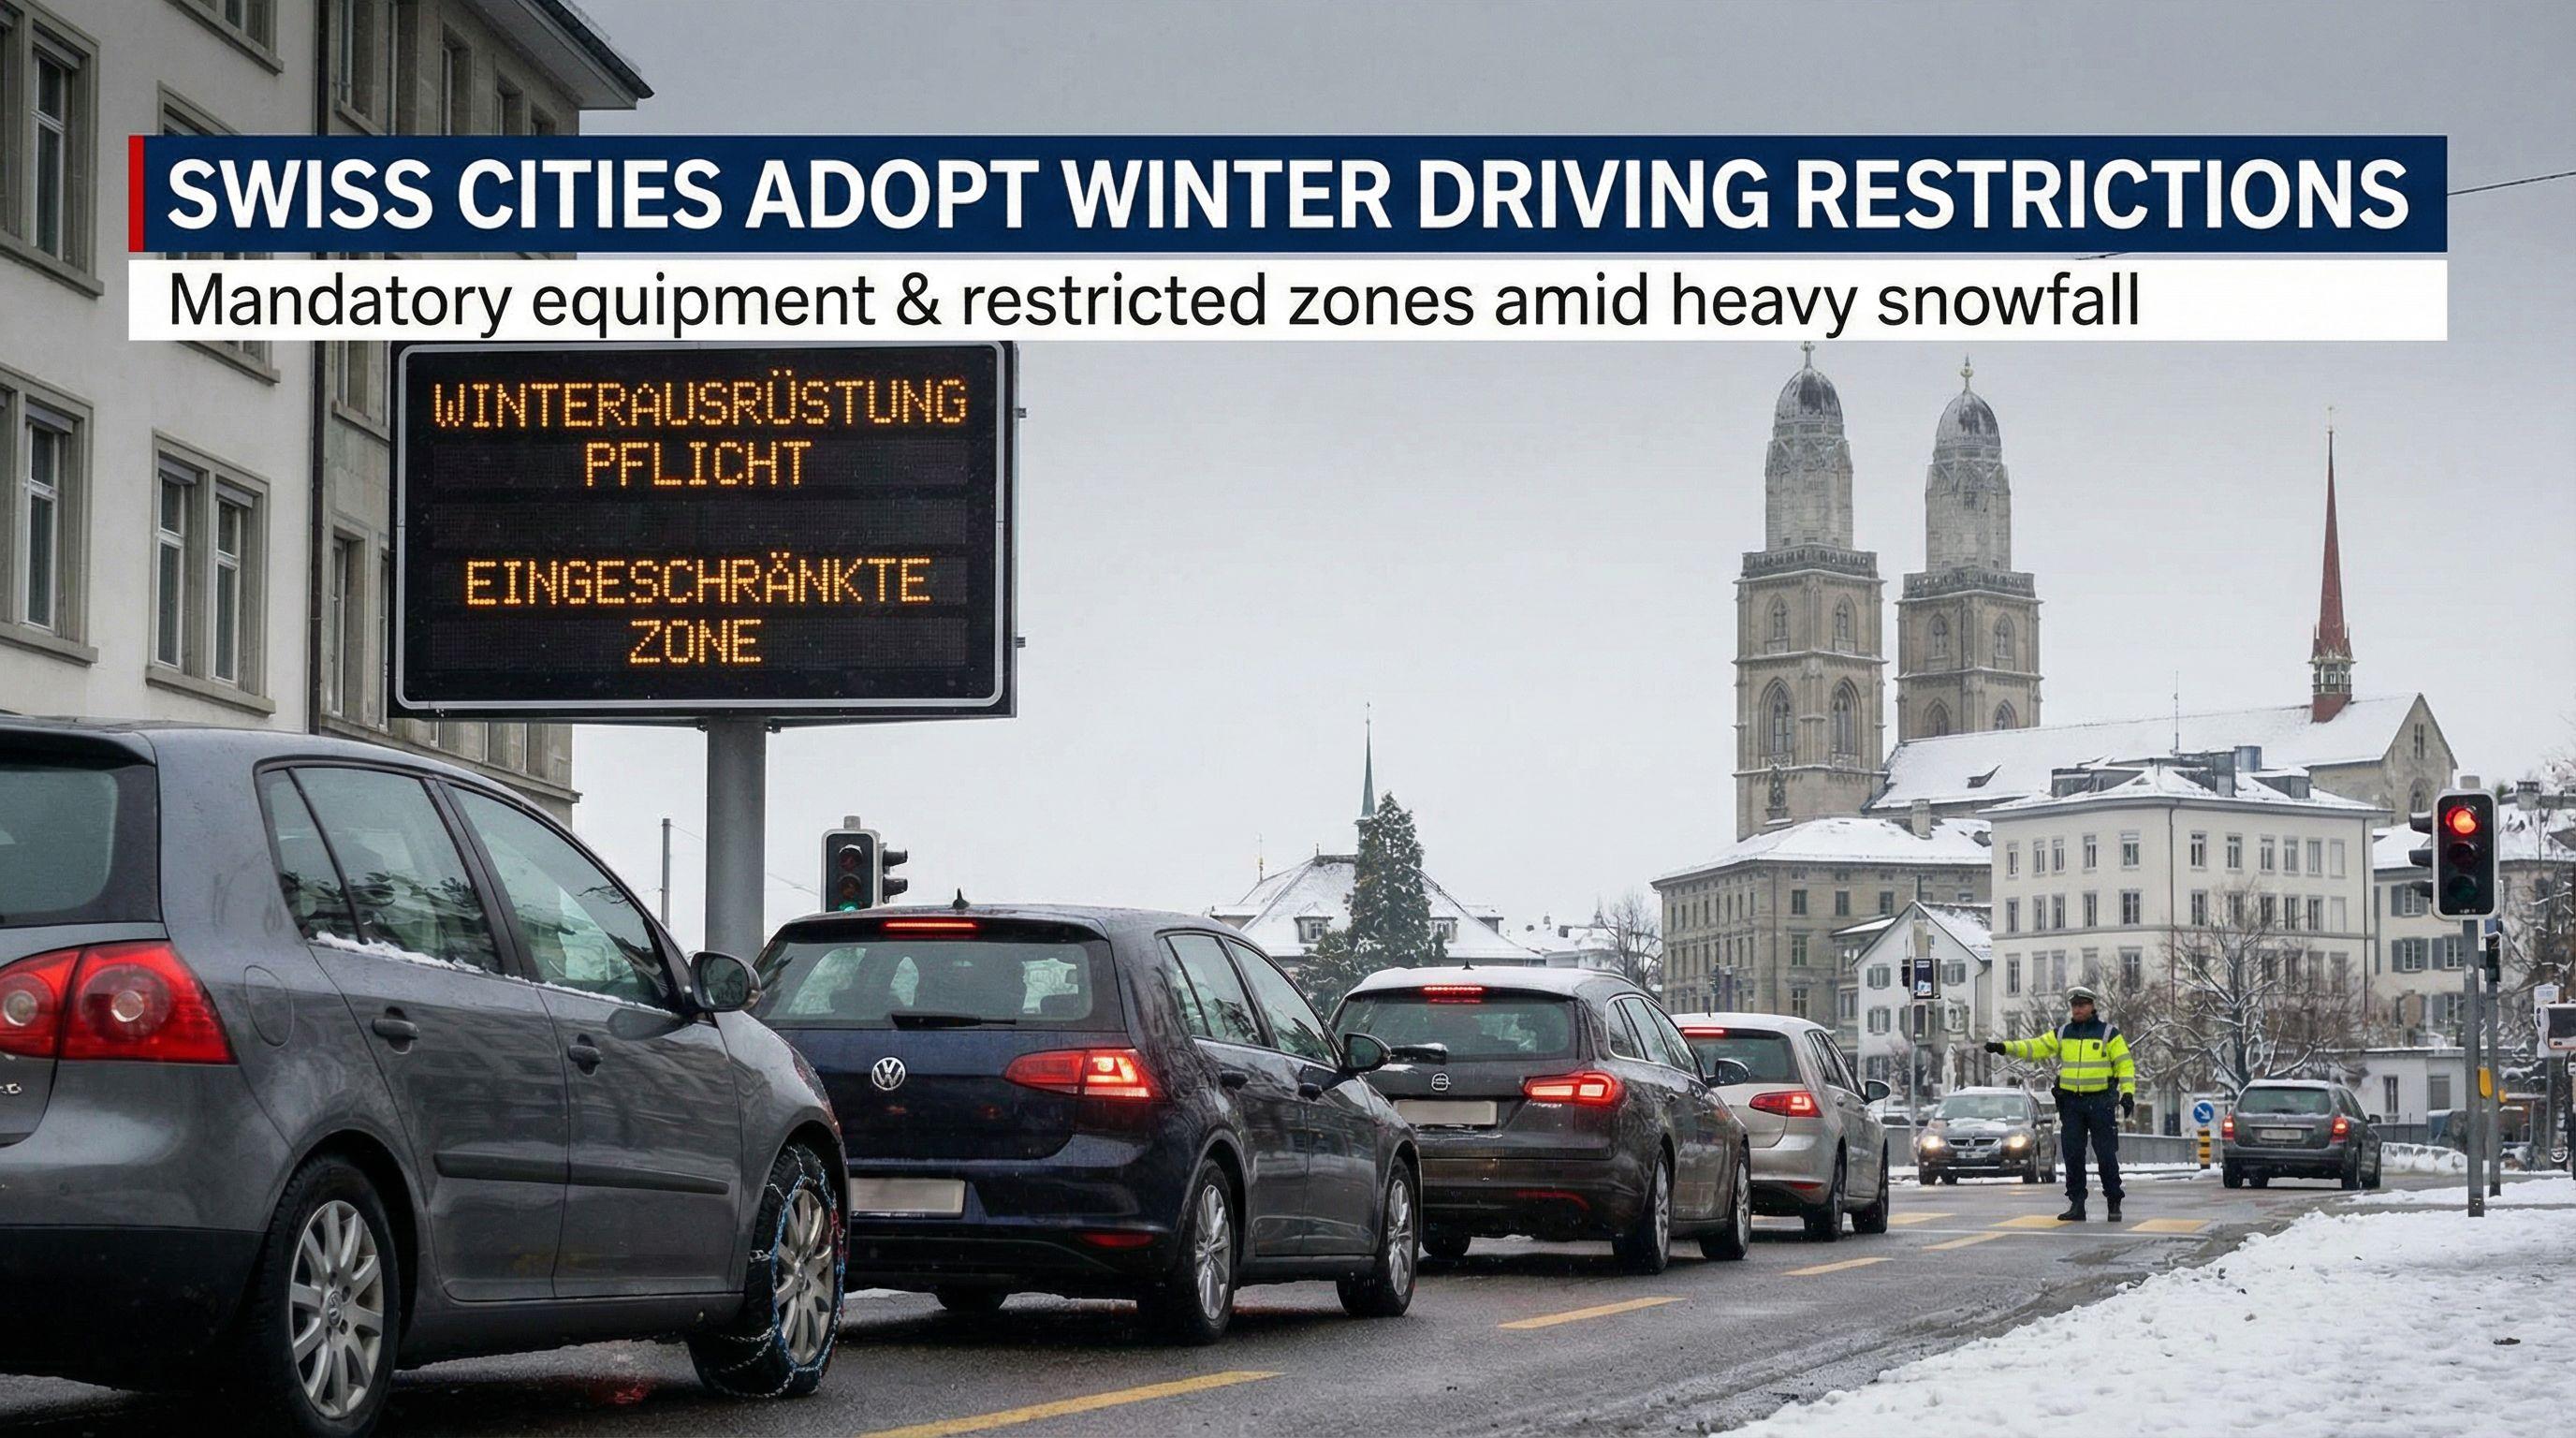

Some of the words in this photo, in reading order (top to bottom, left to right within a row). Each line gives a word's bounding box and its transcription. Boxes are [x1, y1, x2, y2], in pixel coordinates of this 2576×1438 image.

[433, 369, 967, 429] WINTERAUSRÜSTUNG
[585, 440, 812, 488] PFLICHT
[466, 550, 931, 607] EINGESCHRÄNKTE
[629, 618, 763, 665] ZONE
